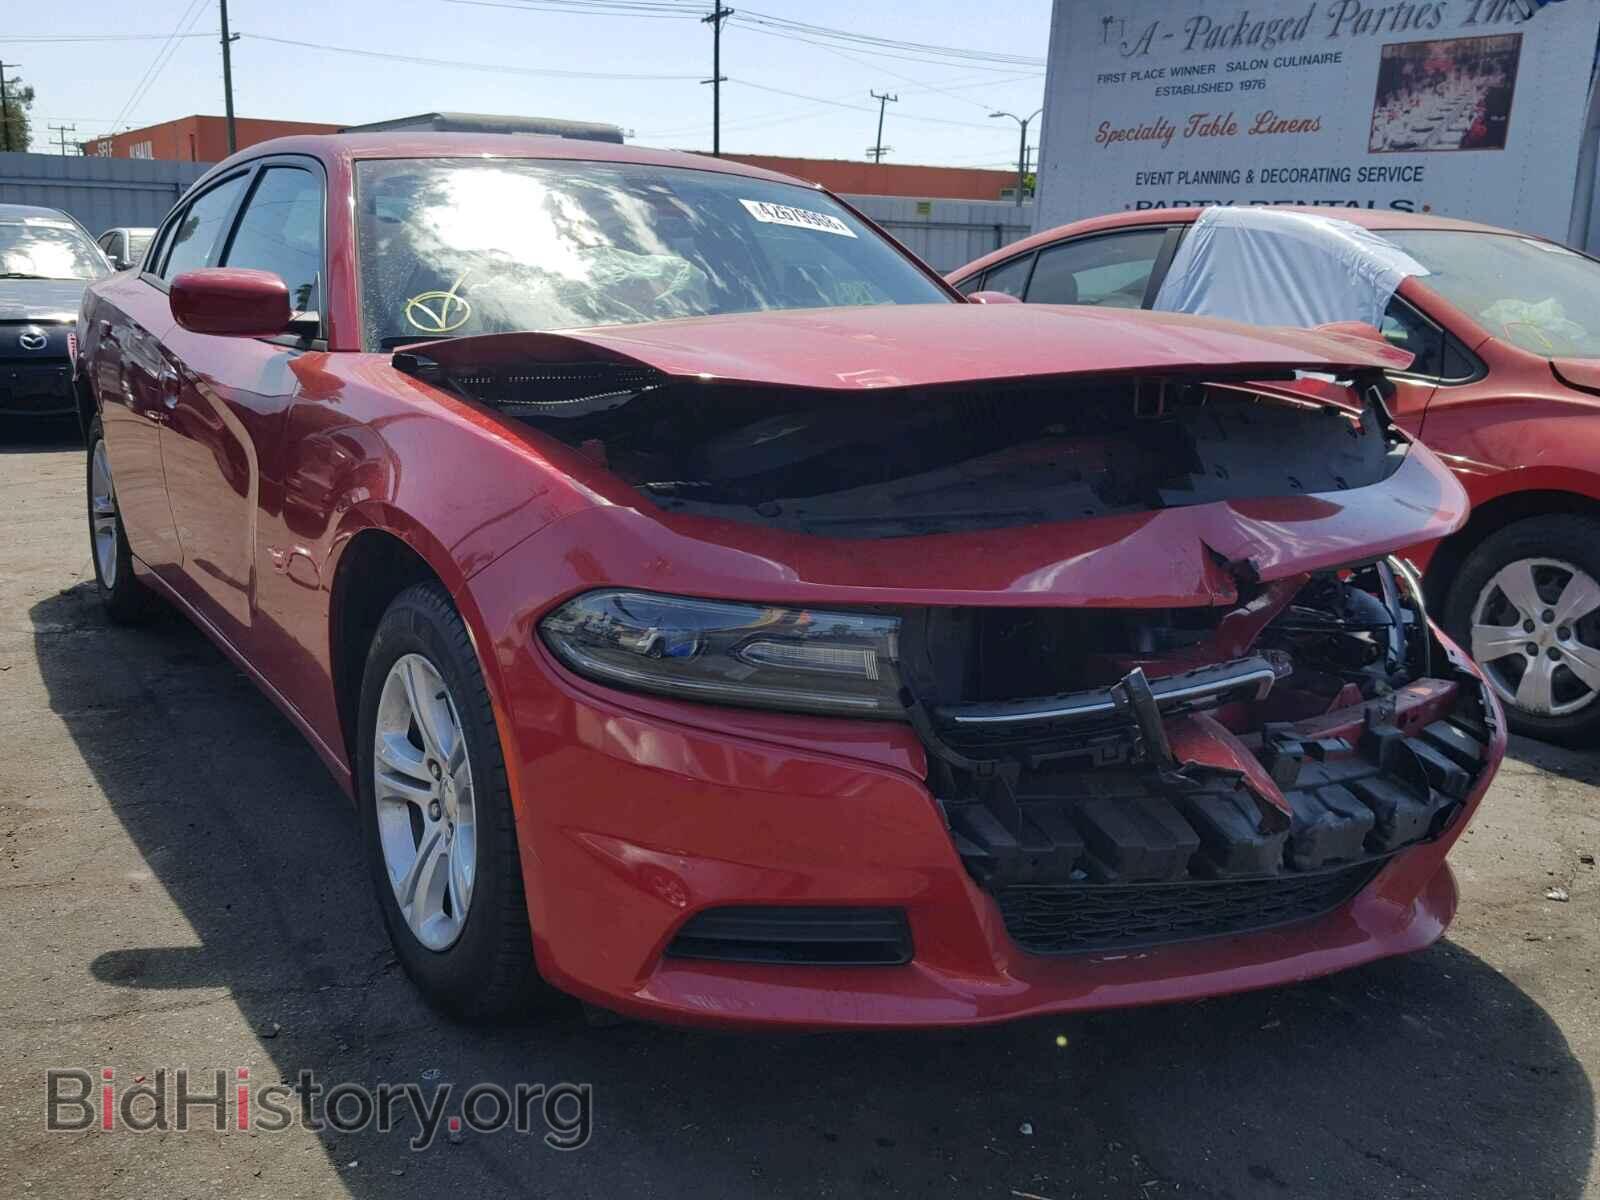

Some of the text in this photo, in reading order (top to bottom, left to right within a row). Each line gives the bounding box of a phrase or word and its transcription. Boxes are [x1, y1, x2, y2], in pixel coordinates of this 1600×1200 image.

[1185, 3, 1316, 50] Packaged
[1328, 0, 1446, 38] Parties
[1097, 52, 1343, 84] FIRST PLACE WINNER SALON CULINAIRE
[1155, 79, 1267, 96] ESTABLISHED 1976
[1095, 111, 1321, 149] Specialty Table Linens
[1135, 166, 1424, 186] EVENT PLANNING & DECORATING SERVICE
